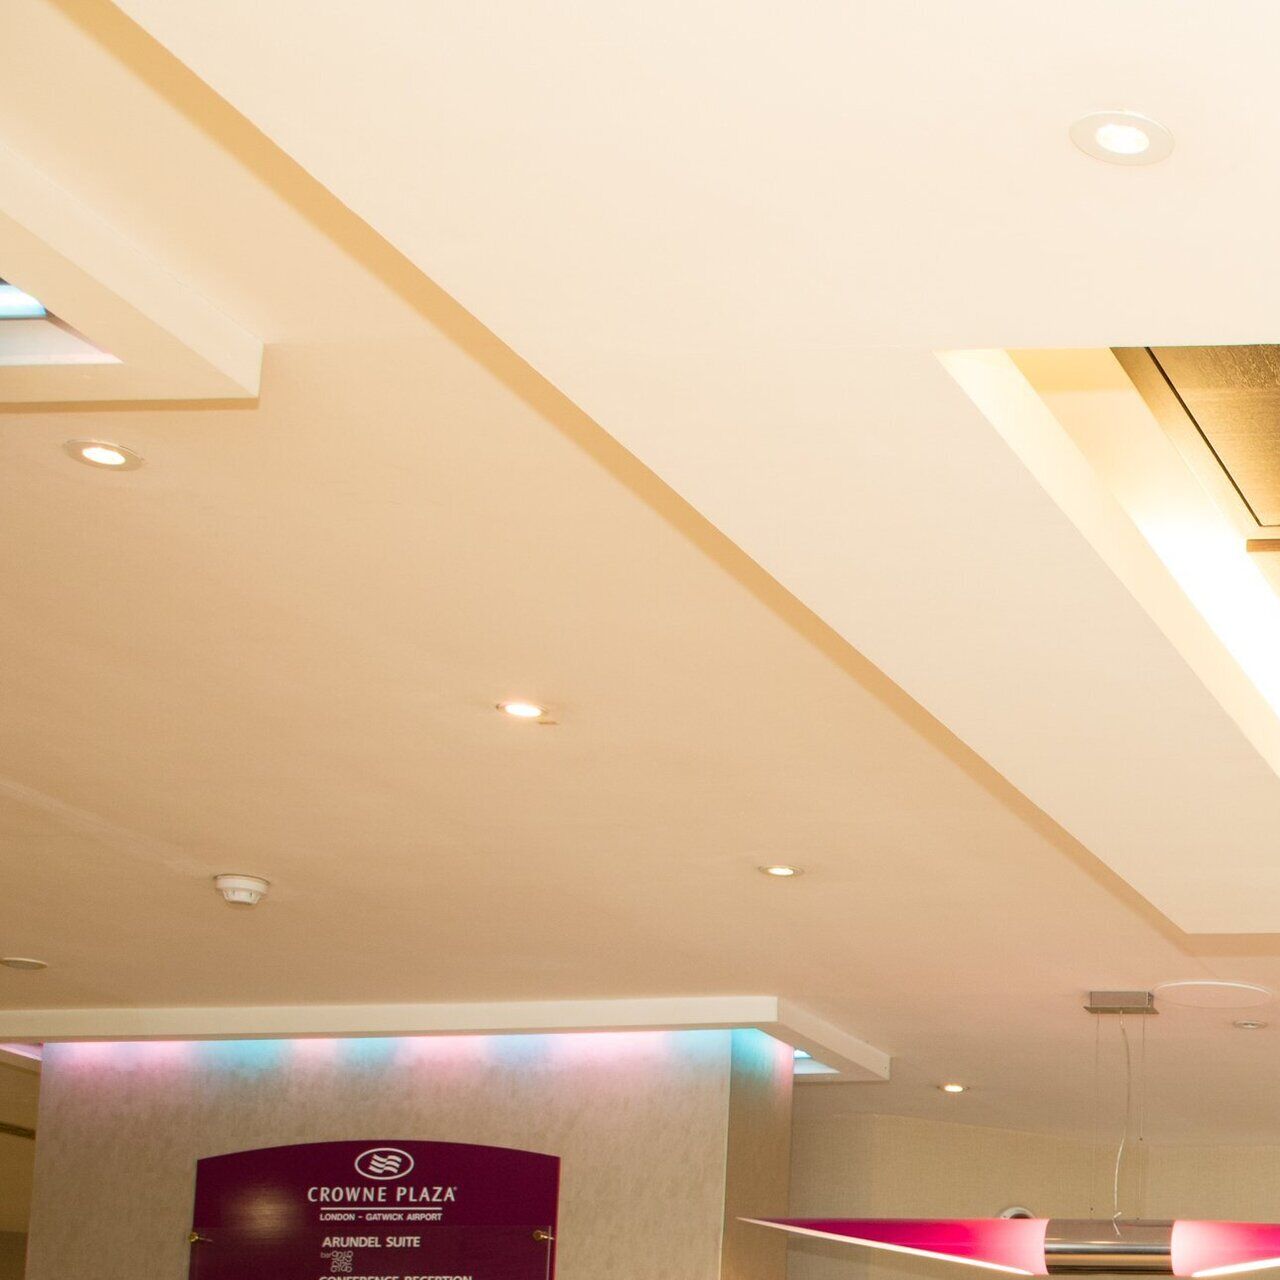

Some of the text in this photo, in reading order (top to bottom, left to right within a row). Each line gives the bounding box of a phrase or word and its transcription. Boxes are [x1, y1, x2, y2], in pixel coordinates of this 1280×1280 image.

[307, 1186, 456, 1202] CROWNE PLAZA
[319, 1213, 355, 1221] LONDON
[366, 1213, 404, 1221] GATWICK
[406, 1213, 443, 1221] AIRPORT
[322, 1236, 421, 1247] ARUNDEL SUITE
